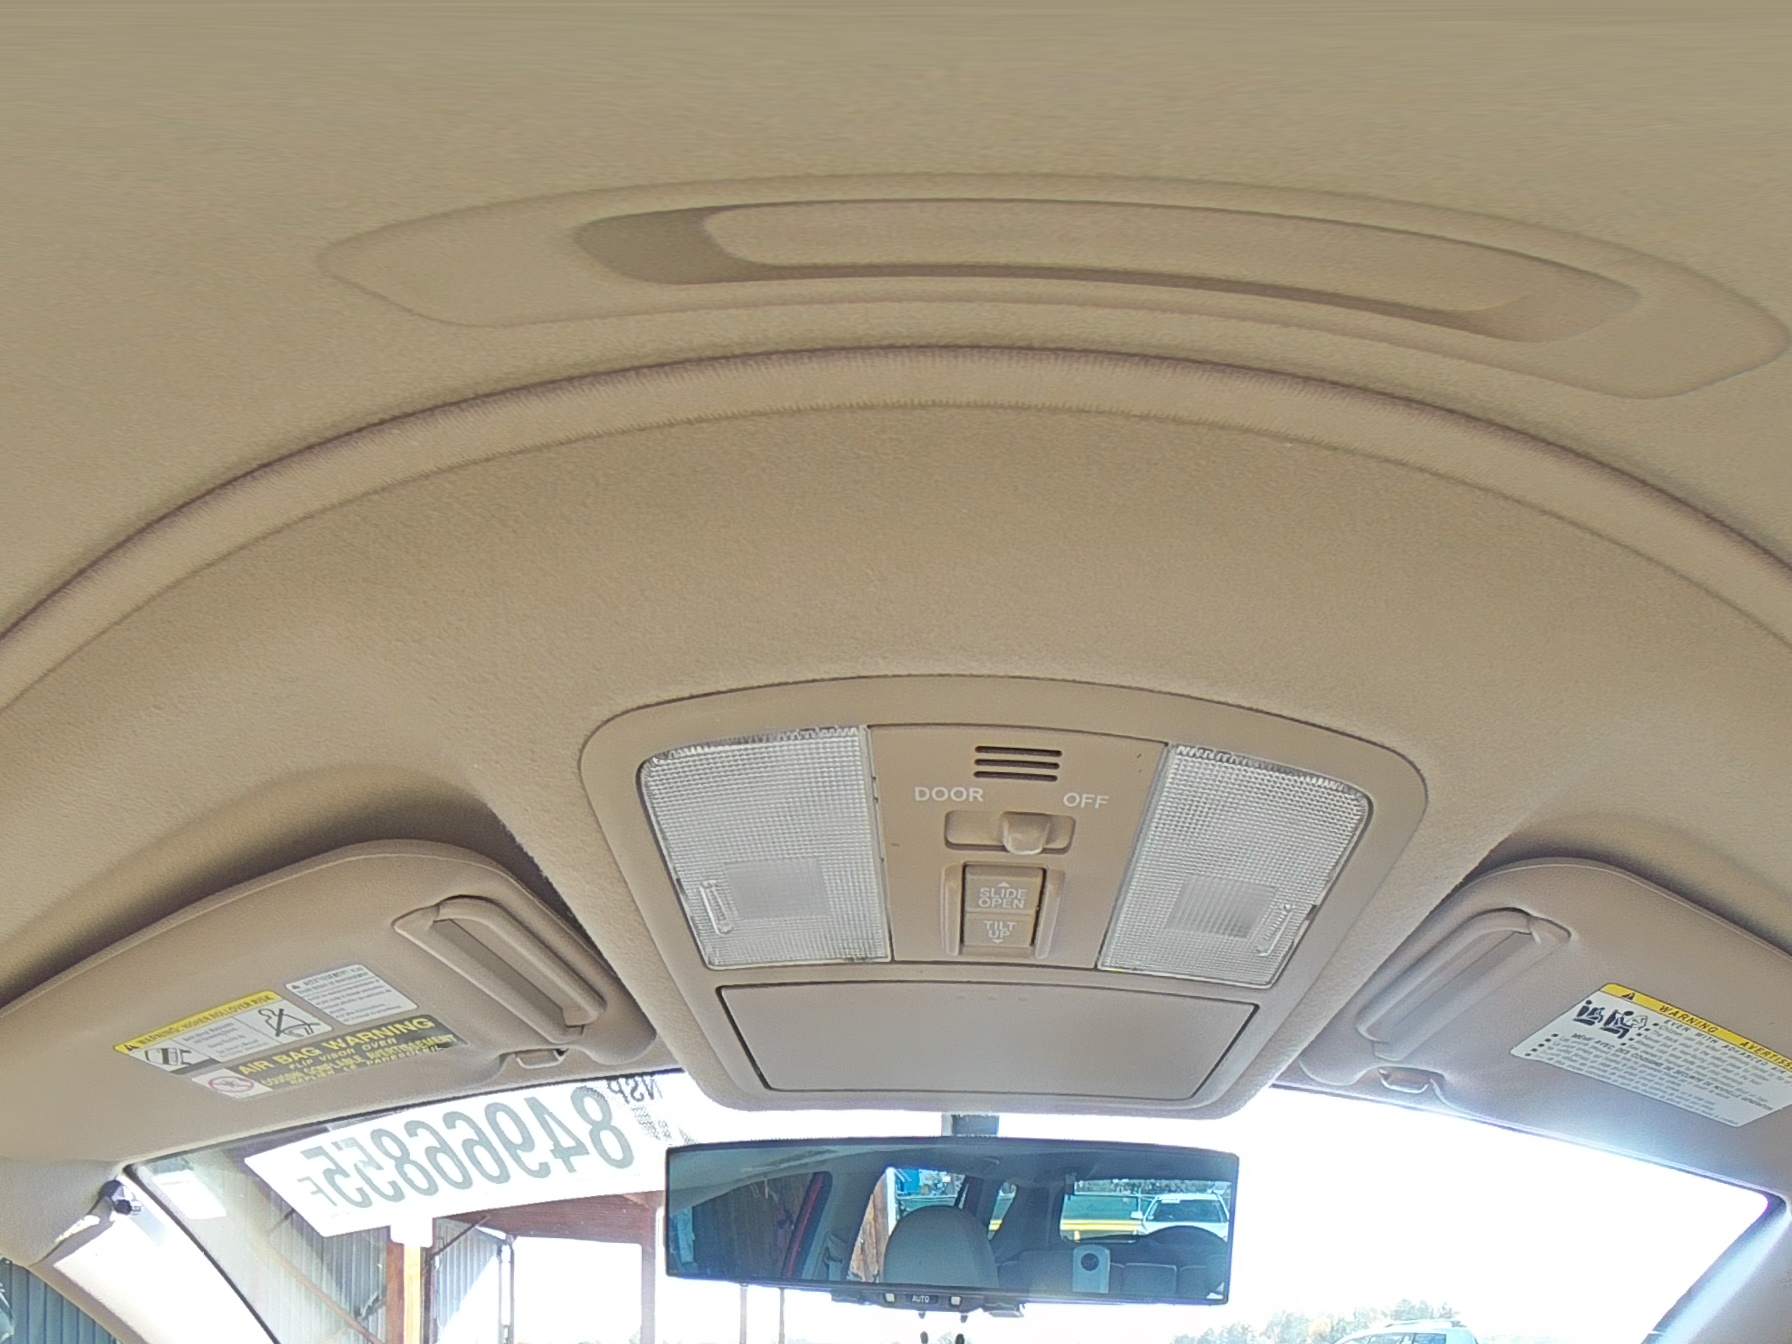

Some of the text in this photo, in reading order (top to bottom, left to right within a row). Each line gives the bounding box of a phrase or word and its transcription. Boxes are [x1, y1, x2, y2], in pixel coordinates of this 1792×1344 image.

[914, 786, 984, 802] DOOR
[1063, 792, 1109, 809] OFF
[979, 887, 1027, 900] SLIDE
[978, 898, 1025, 909] OPEN
[983, 920, 1017, 931] TILT
[988, 929, 1010, 939] UP
[1659, 1004, 1719, 1034] WARNING
[238, 1017, 436, 1076] AIR BAG WARNING
